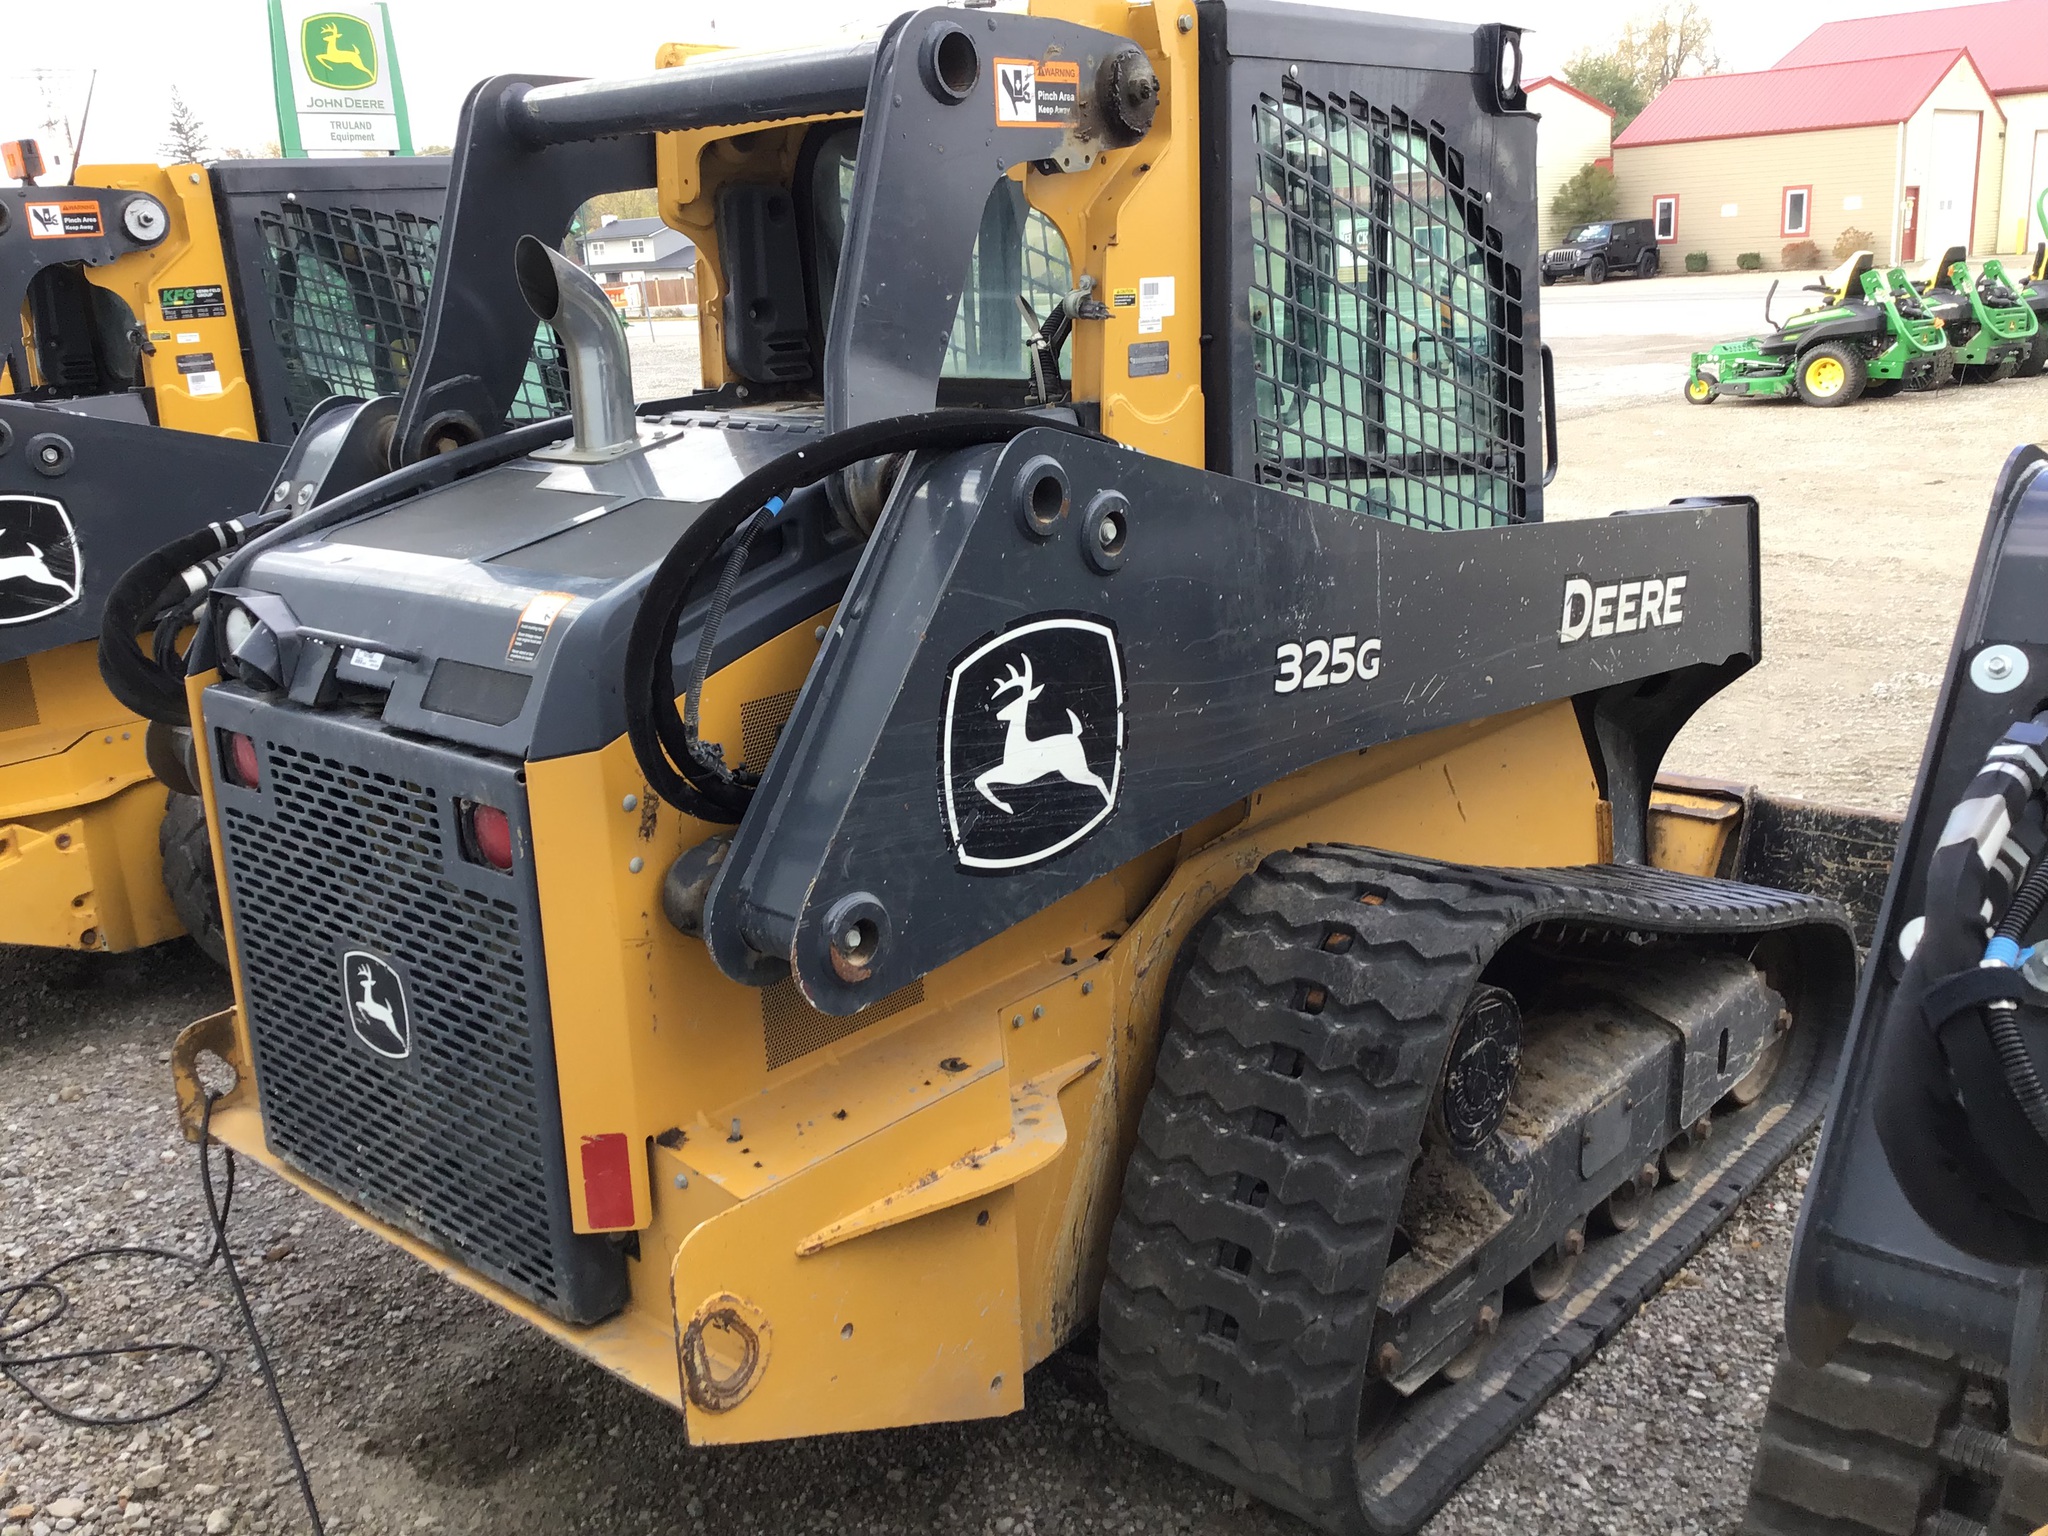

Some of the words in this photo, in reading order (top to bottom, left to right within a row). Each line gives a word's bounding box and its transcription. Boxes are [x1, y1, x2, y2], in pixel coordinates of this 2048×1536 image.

[1044, 68, 1076, 78] WARNING
[1037, 90, 1058, 101] Pinch
[1059, 91, 1075, 101] Area
[306, 96, 343, 108] JOHN
[344, 97, 385, 109] DEERE
[1038, 105, 1054, 115] Keep
[1054, 105, 1071, 115] Away
[330, 121, 372, 130] TRULAND
[330, 132, 375, 142] Equipment
[163, 288, 195, 302] KFG
[1560, 575, 1687, 643] DEERE
[1274, 635, 1382, 693] 325G
